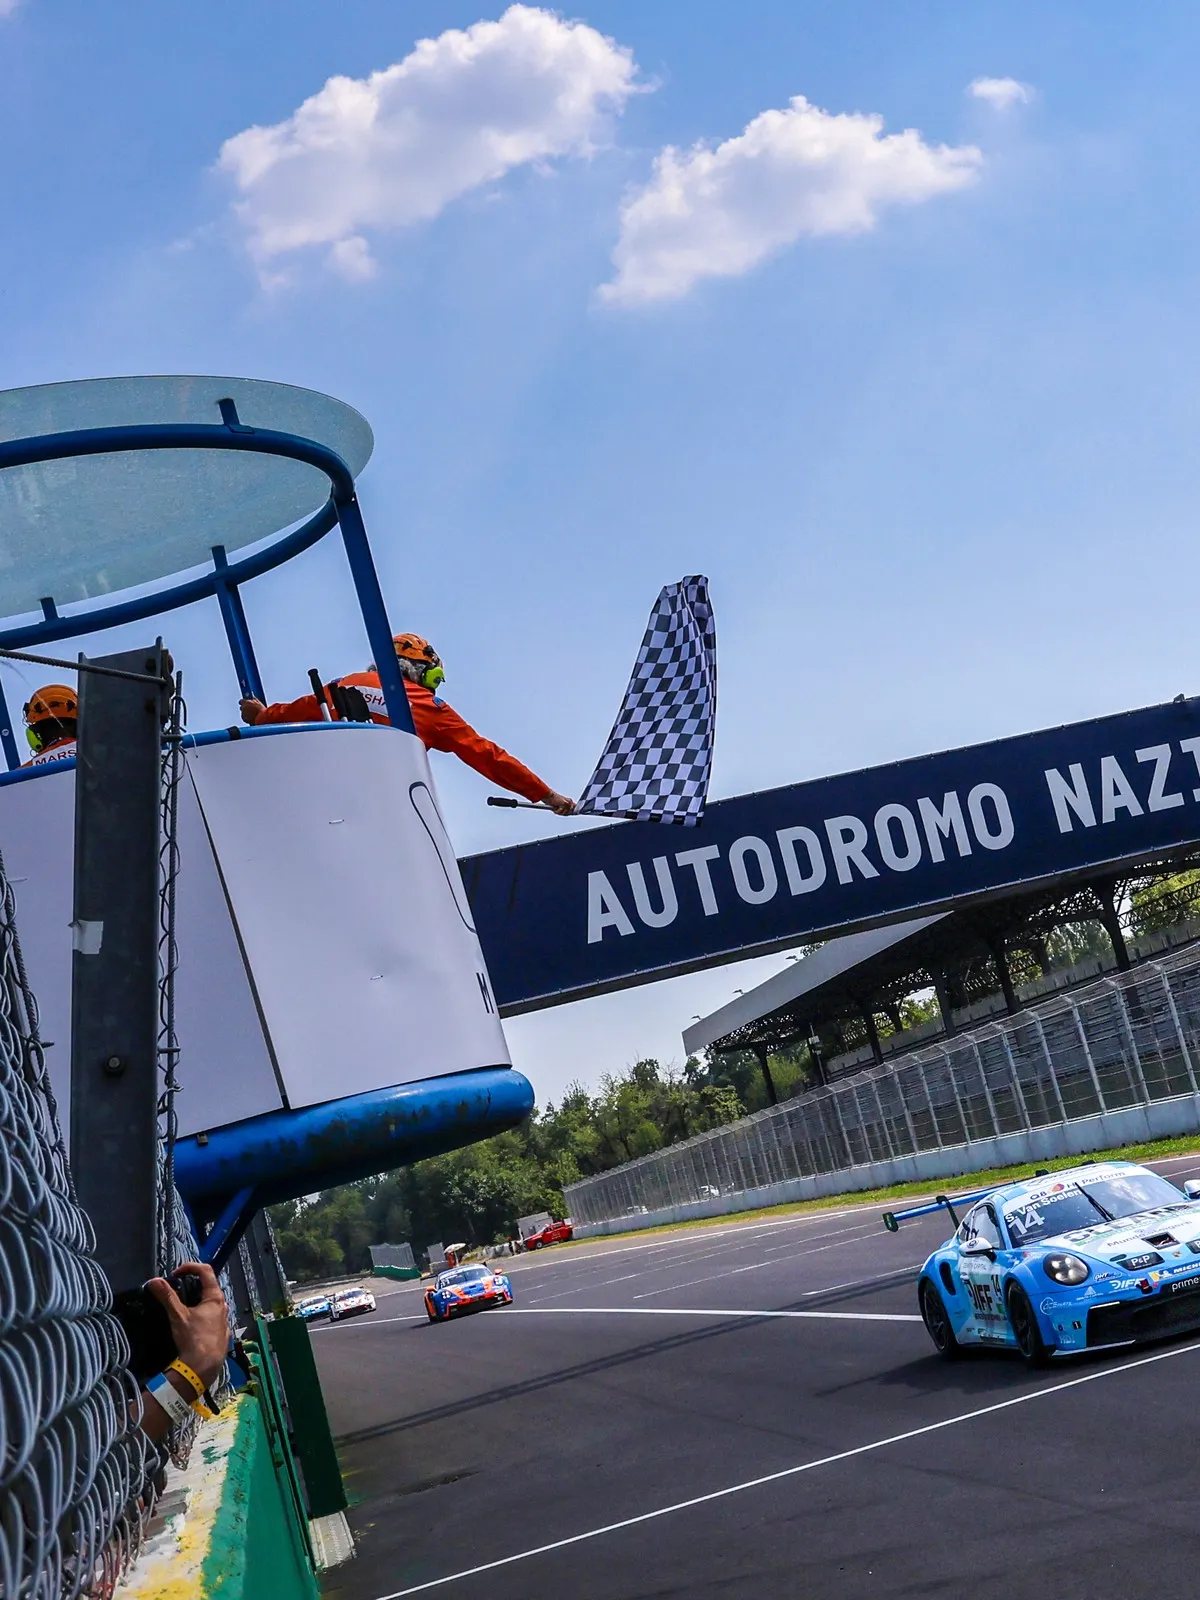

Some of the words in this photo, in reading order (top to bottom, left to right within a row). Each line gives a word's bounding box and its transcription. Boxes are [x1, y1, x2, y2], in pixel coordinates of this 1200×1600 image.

[587, 782, 1015, 945] AUTODROMO
[1082, 1172, 1126, 1184] Perform
[1005, 1213, 1018, 1223] S.
[1017, 1201, 1041, 1216] Van
[1040, 1189, 1083, 1206] Soelen
[1008, 1210, 1045, 1235] 14
[1131, 1255, 1150, 1266] P&P
[991, 1274, 1002, 1297] 14
